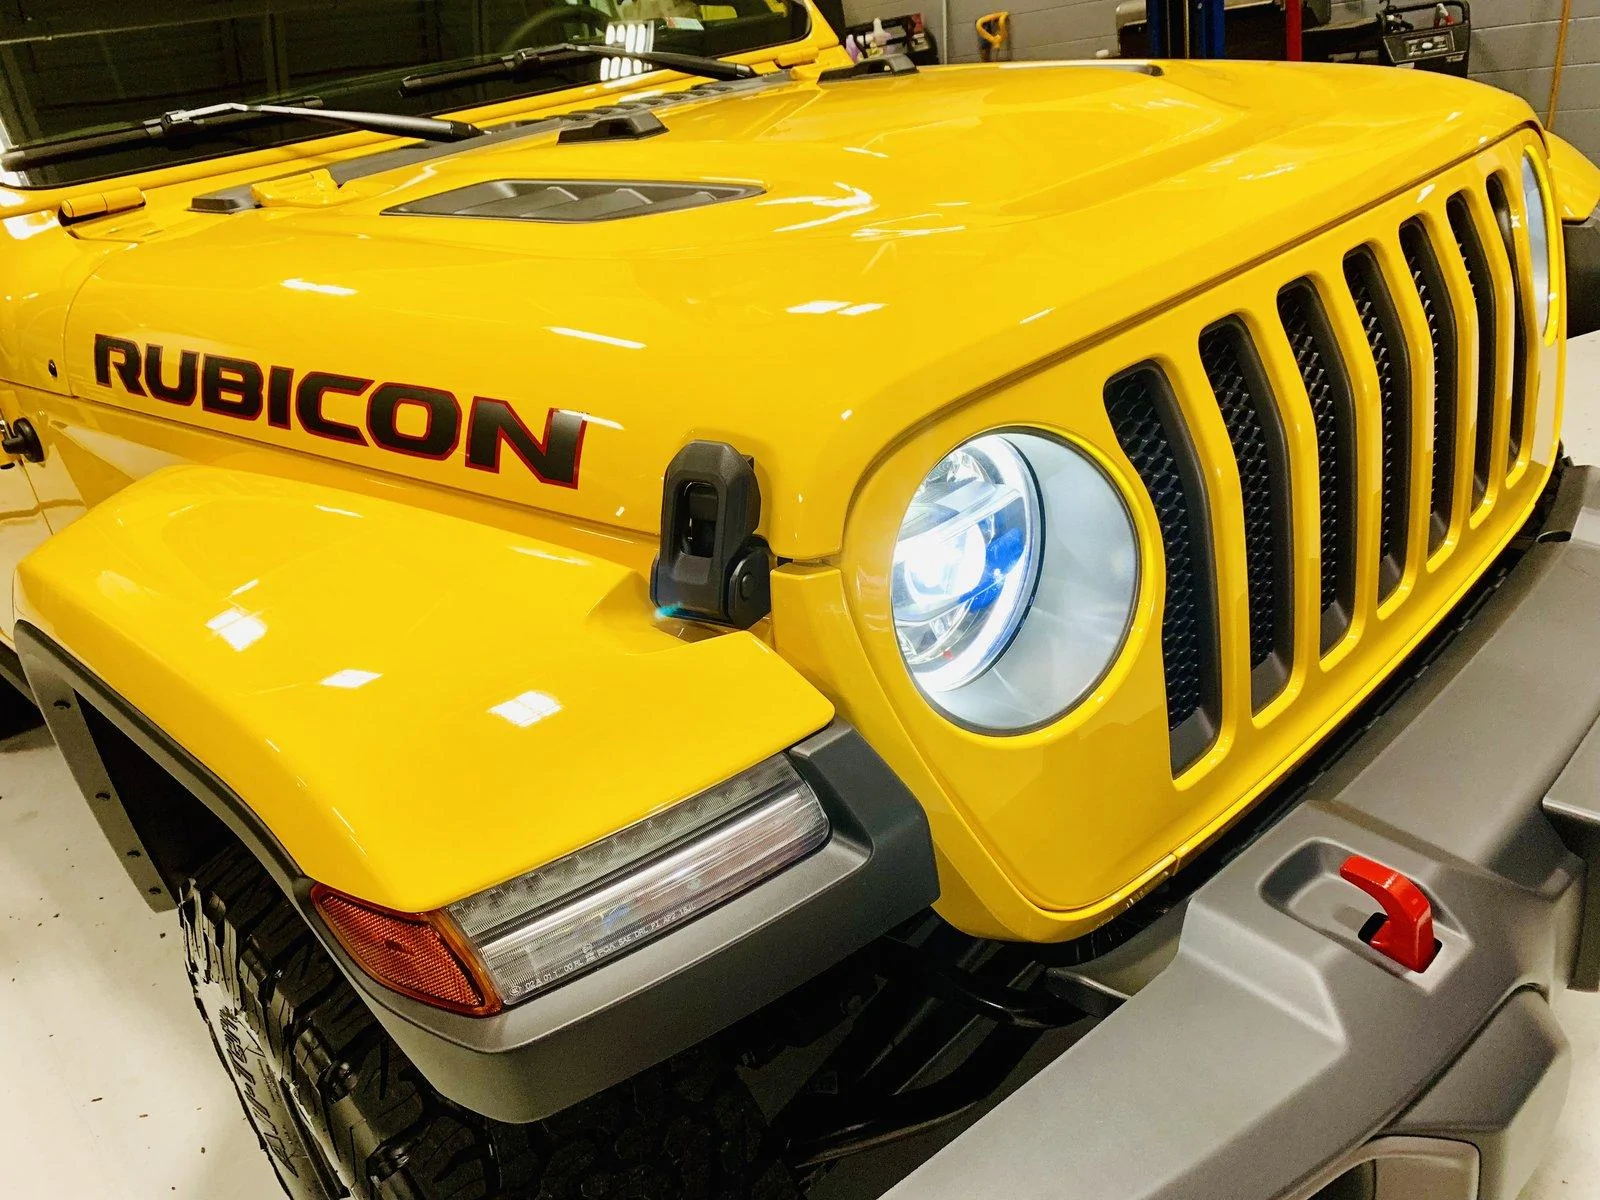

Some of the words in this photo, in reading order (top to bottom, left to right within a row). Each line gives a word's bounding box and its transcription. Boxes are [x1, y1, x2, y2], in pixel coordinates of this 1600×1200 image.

[95, 333, 587, 489] RUBICON
[618, 935, 632, 946] SAE
[634, 927, 649, 938] DRL
